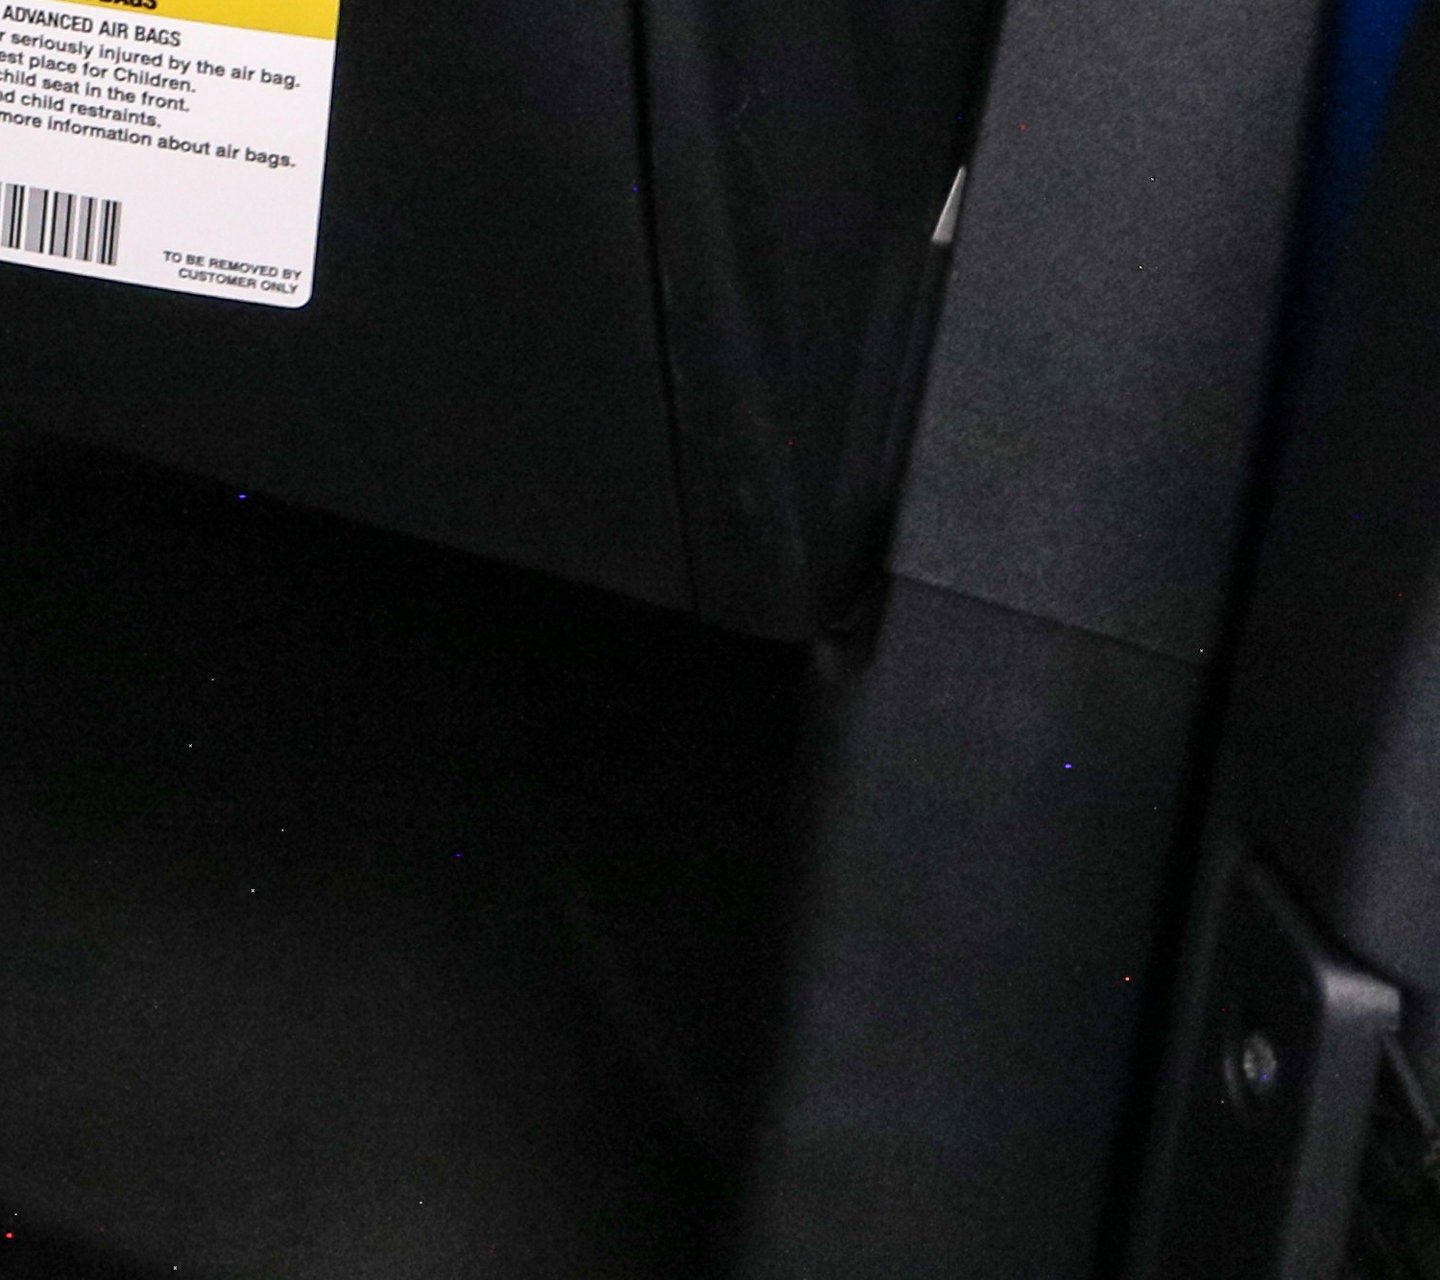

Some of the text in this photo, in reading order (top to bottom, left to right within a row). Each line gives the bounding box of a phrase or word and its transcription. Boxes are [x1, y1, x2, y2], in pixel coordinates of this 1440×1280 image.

[2, 4, 94, 34] ADVANCED
[98, 20, 130, 40] AIR
[134, 25, 182, 48] BAGS
[11, 33, 95, 61] seriously
[99, 44, 164, 68] injured
[168, 55, 192, 76] by
[196, 60, 226, 78] the
[230, 66, 256, 82] air
[260, 68, 301, 91] bag.
[28, 52, 78, 77] place
[82, 61, 109, 79] for
[113, 67, 196, 94] Children.
[20, 93, 66, 113] child
[70, 103, 162, 129] restraints.
[42, 78, 80, 96] seat
[85, 81, 102, 99] in
[107, 86, 137, 104] the
[141, 91, 190, 113] front.
[47, 116, 153, 147] information
[157, 135, 211, 156] about
[215, 144, 241, 160] air
[245, 147, 296, 170] bags.
[163, 250, 303, 282] TO BE REMOVED BY
[178, 267, 299, 296] CUSTOMER ONLY
